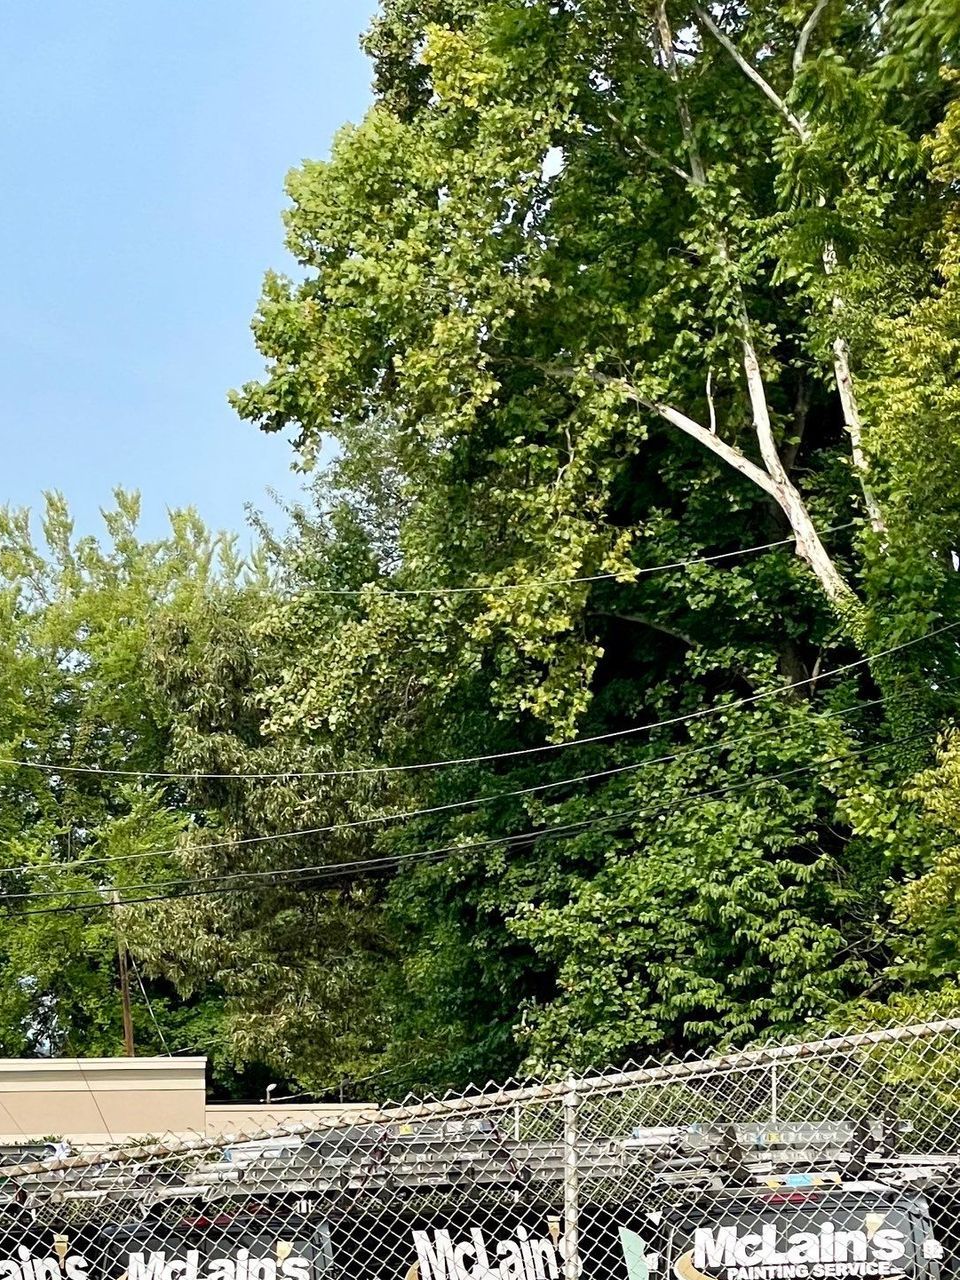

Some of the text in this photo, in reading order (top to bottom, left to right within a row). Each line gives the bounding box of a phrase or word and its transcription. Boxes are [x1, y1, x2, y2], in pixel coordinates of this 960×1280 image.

[694, 1222, 906, 1268] McLain's
[727, 1266, 809, 1280] PAINTING
[813, 1262, 891, 1277] SERVICE
